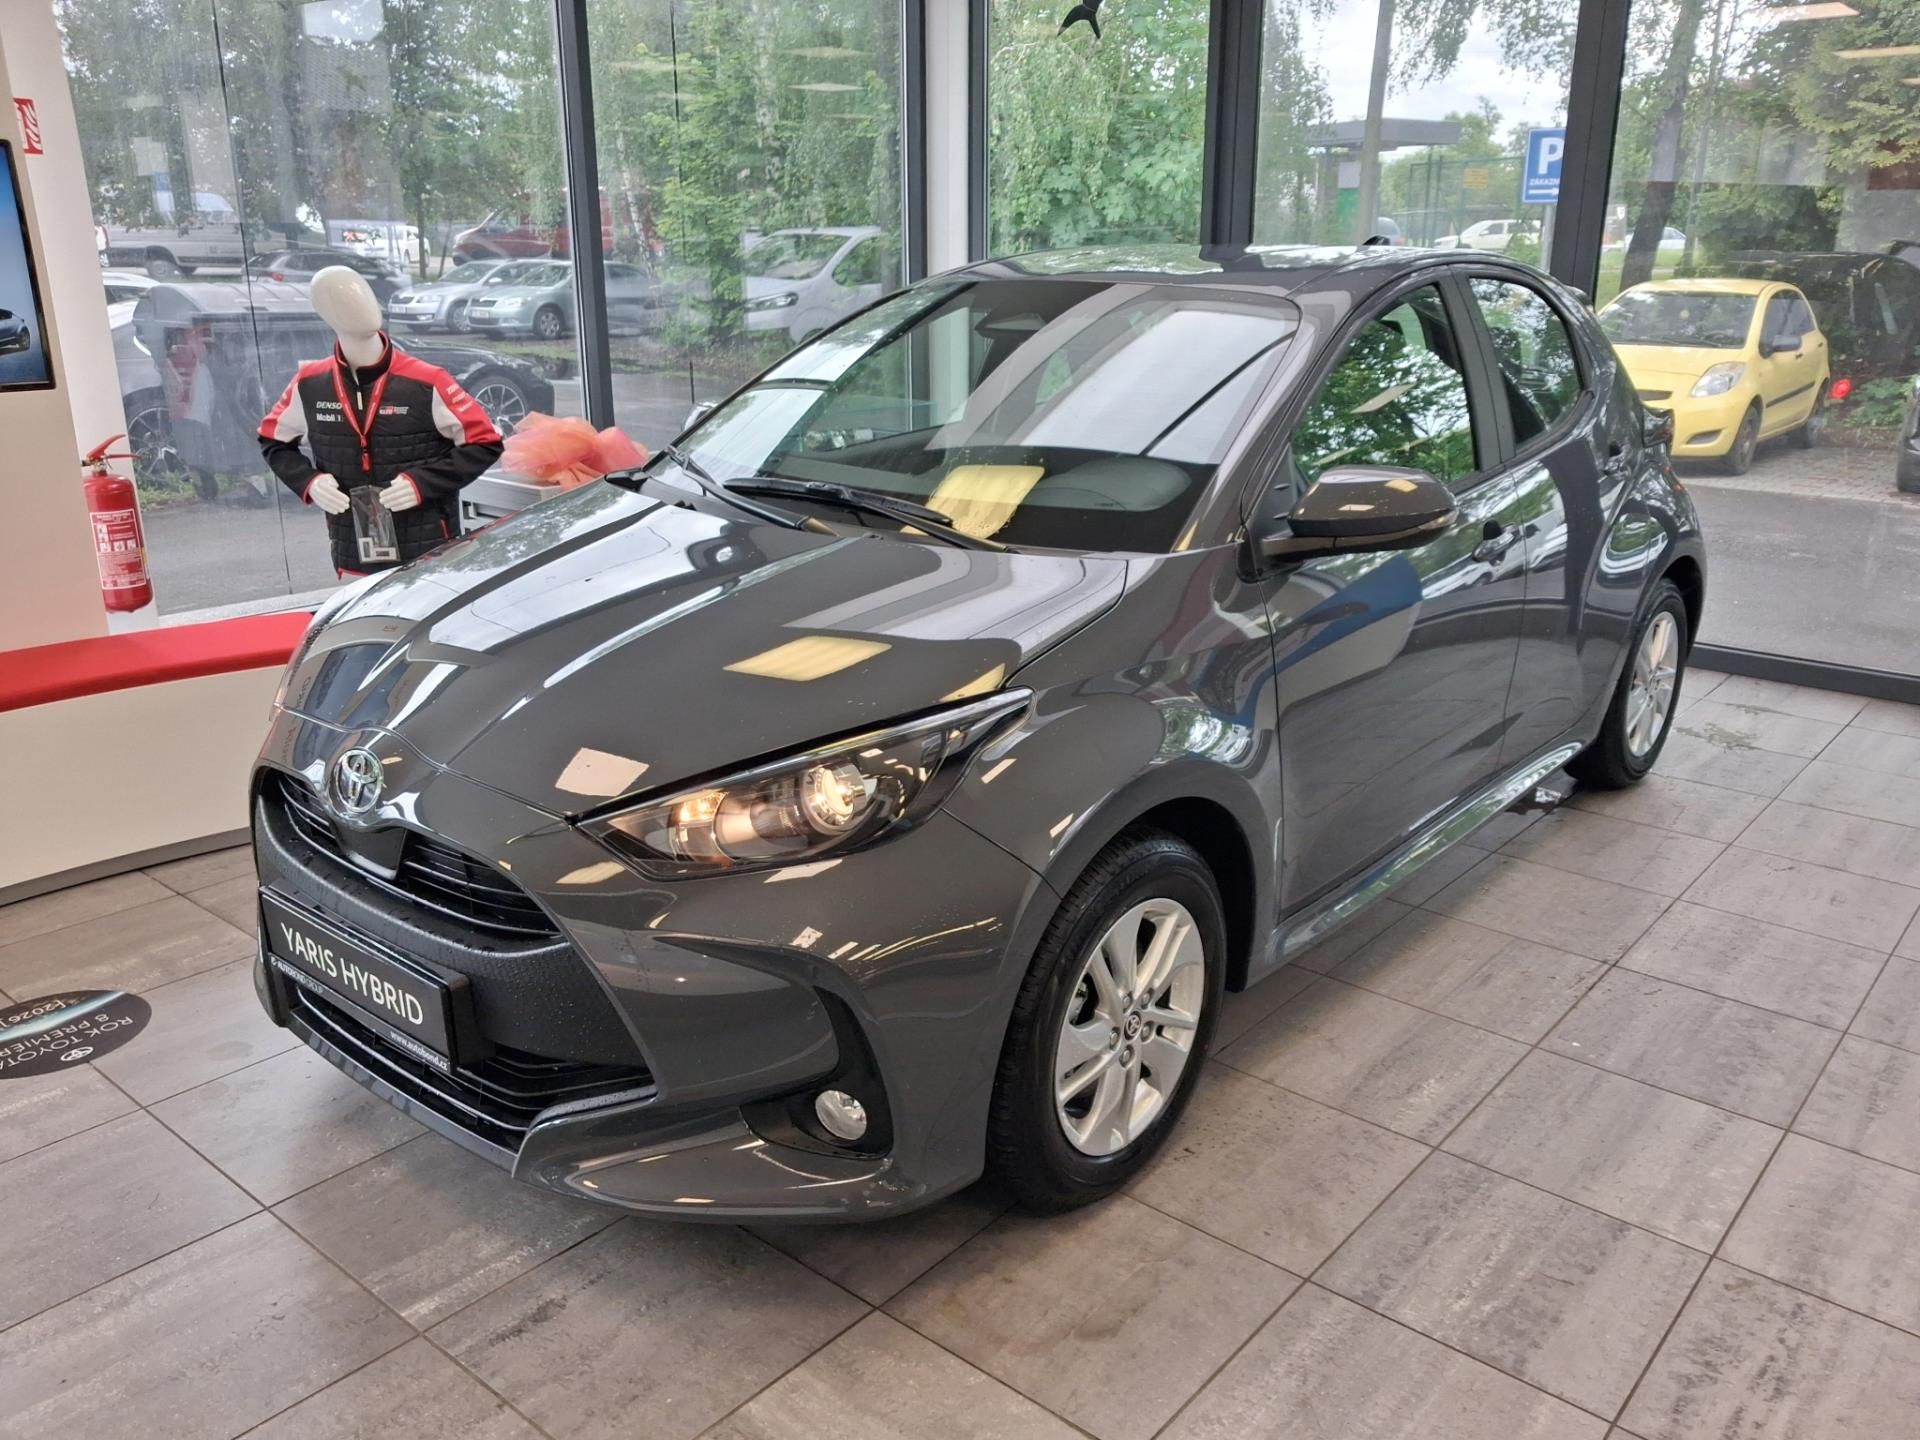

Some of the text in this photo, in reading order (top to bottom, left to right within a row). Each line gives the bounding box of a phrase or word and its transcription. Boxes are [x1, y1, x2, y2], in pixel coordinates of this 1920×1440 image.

[1538, 137, 1565, 174] P
[316, 401, 343, 410] DENSO
[316, 413, 335, 422] Mobil
[280, 921, 423, 1025] YARIS HYBRID
[84, 1016, 134, 1038] ROK
[95, 1014, 109, 1022] 8
[390, 1031, 449, 1071] www.autobond.cz
